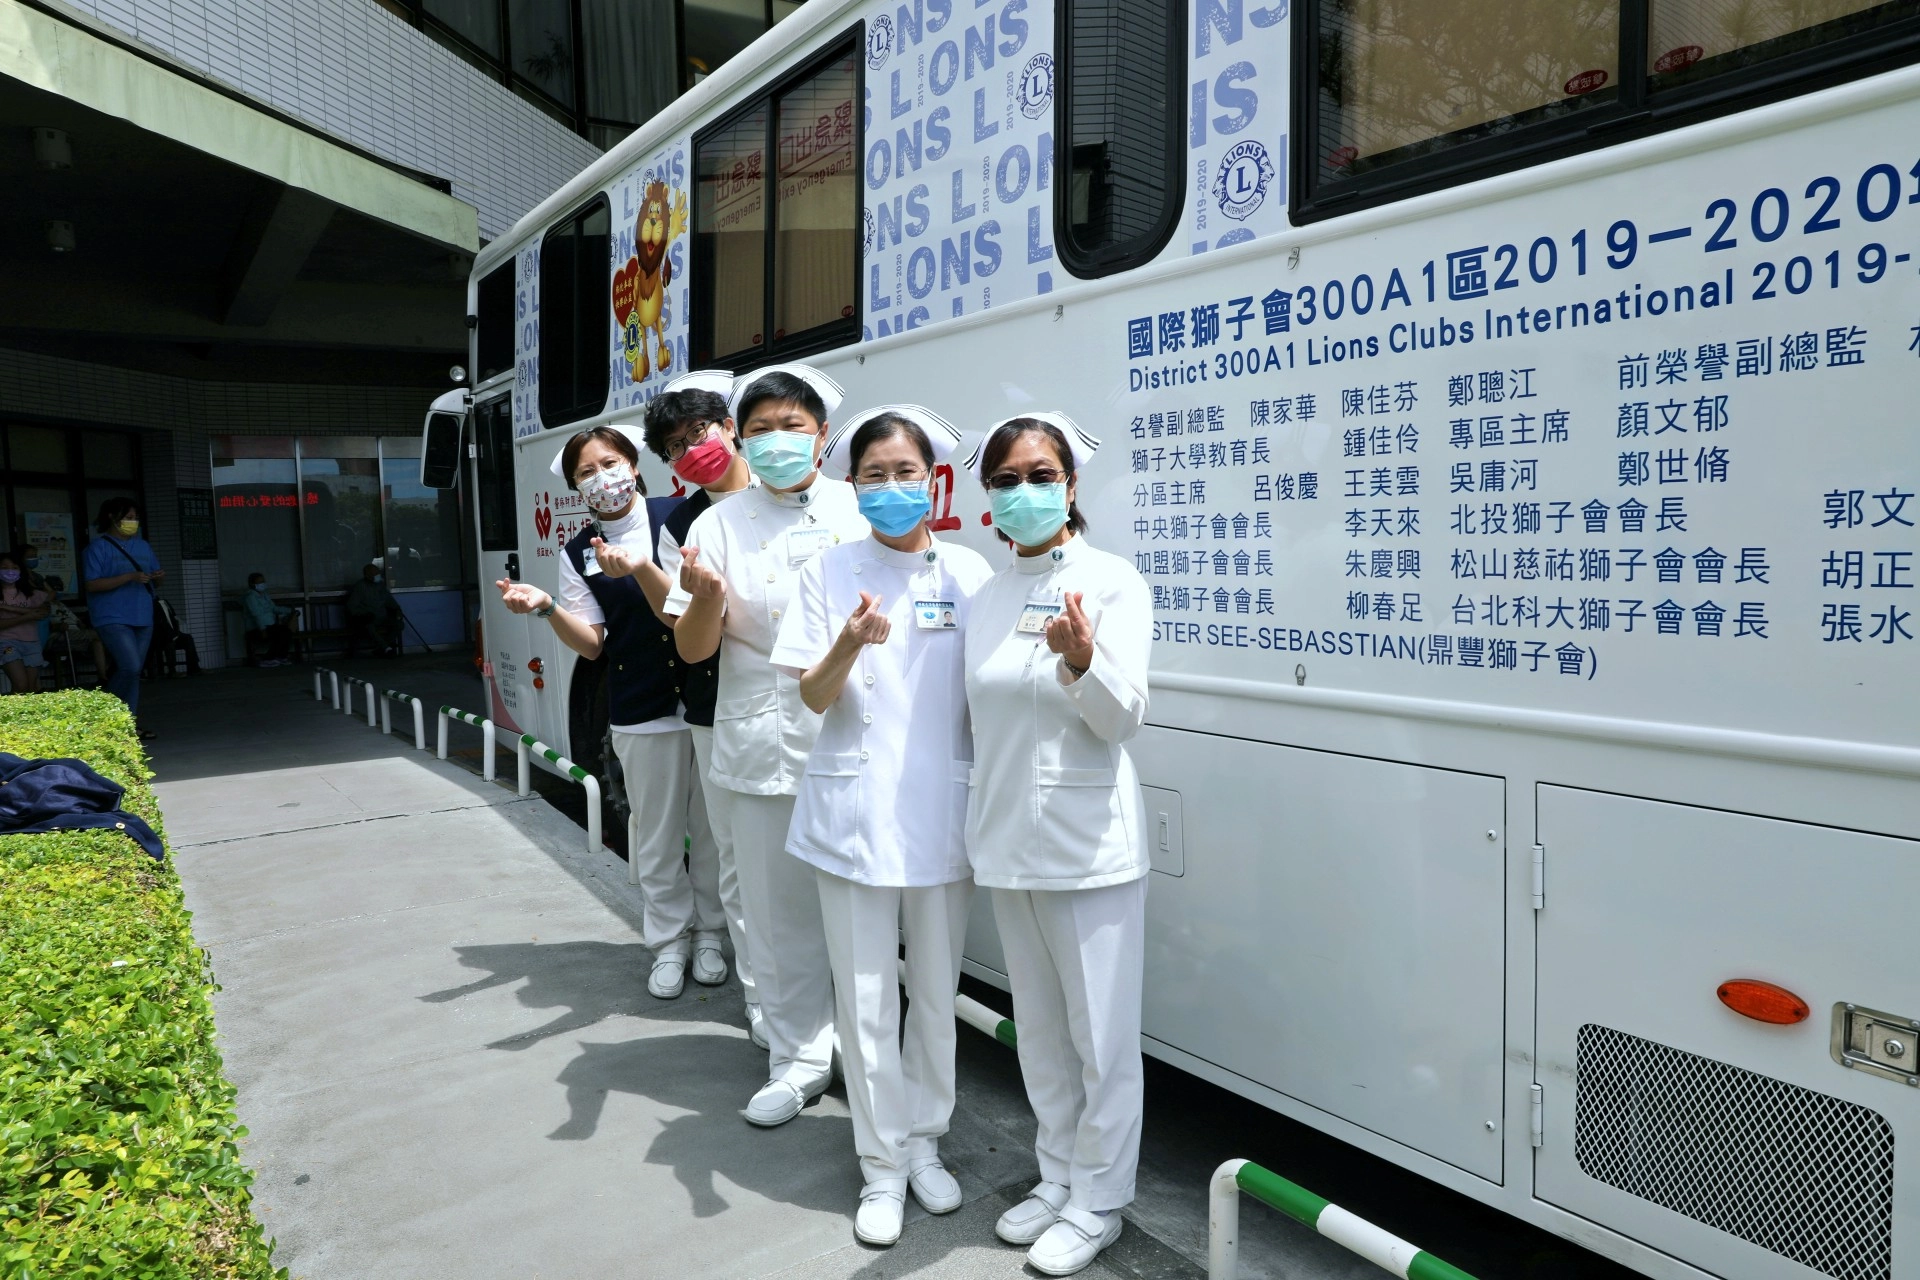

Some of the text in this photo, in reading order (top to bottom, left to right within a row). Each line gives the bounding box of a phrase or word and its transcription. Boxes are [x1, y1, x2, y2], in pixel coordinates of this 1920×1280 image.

[929, 0, 1029, 96] ONS
[1025, 56, 1050, 75] LIONS
[1006, 71, 1014, 131] 2019-2020
[866, 106, 951, 190] ONS
[1226, 144, 1261, 165] LIONS
[1197, 160, 1207, 230] 2019-2020
[1236, 166, 1251, 194] L
[907, 219, 1002, 300] ONS
[1130, 243, 1920, 392] District 300A1 Lions Clubs International 2019-
[1130, 405, 1225, 440] 名譽副總監
[1250, 393, 1317, 427] 陳家華
[1342, 381, 1419, 418] 陳佳芬
[1448, 367, 1538, 407] 鄭聰江
[1617, 325, 1868, 390] 前榮譽副總監
[1132, 394, 1729, 473] 獅子大學教育長 鍾佳伶 專區主席 顏文郁
[1133, 479, 1206, 507] 分區主席
[1253, 471, 1318, 501] 呂俊慶
[1344, 465, 1420, 498] 王美雲
[1450, 458, 1538, 493] 吳庸河
[1133, 487, 1916, 540] 中央獅子會會長 李天來 北投獅子會會長 郭文
[1135, 546, 1915, 589] 加盟獅子會會長 朱慶興 松山慈祐獅子會會長 胡正
[1149, 585, 1915, 644] 點獅子會會長 柳春足 台北科大獅子會會長 張水
